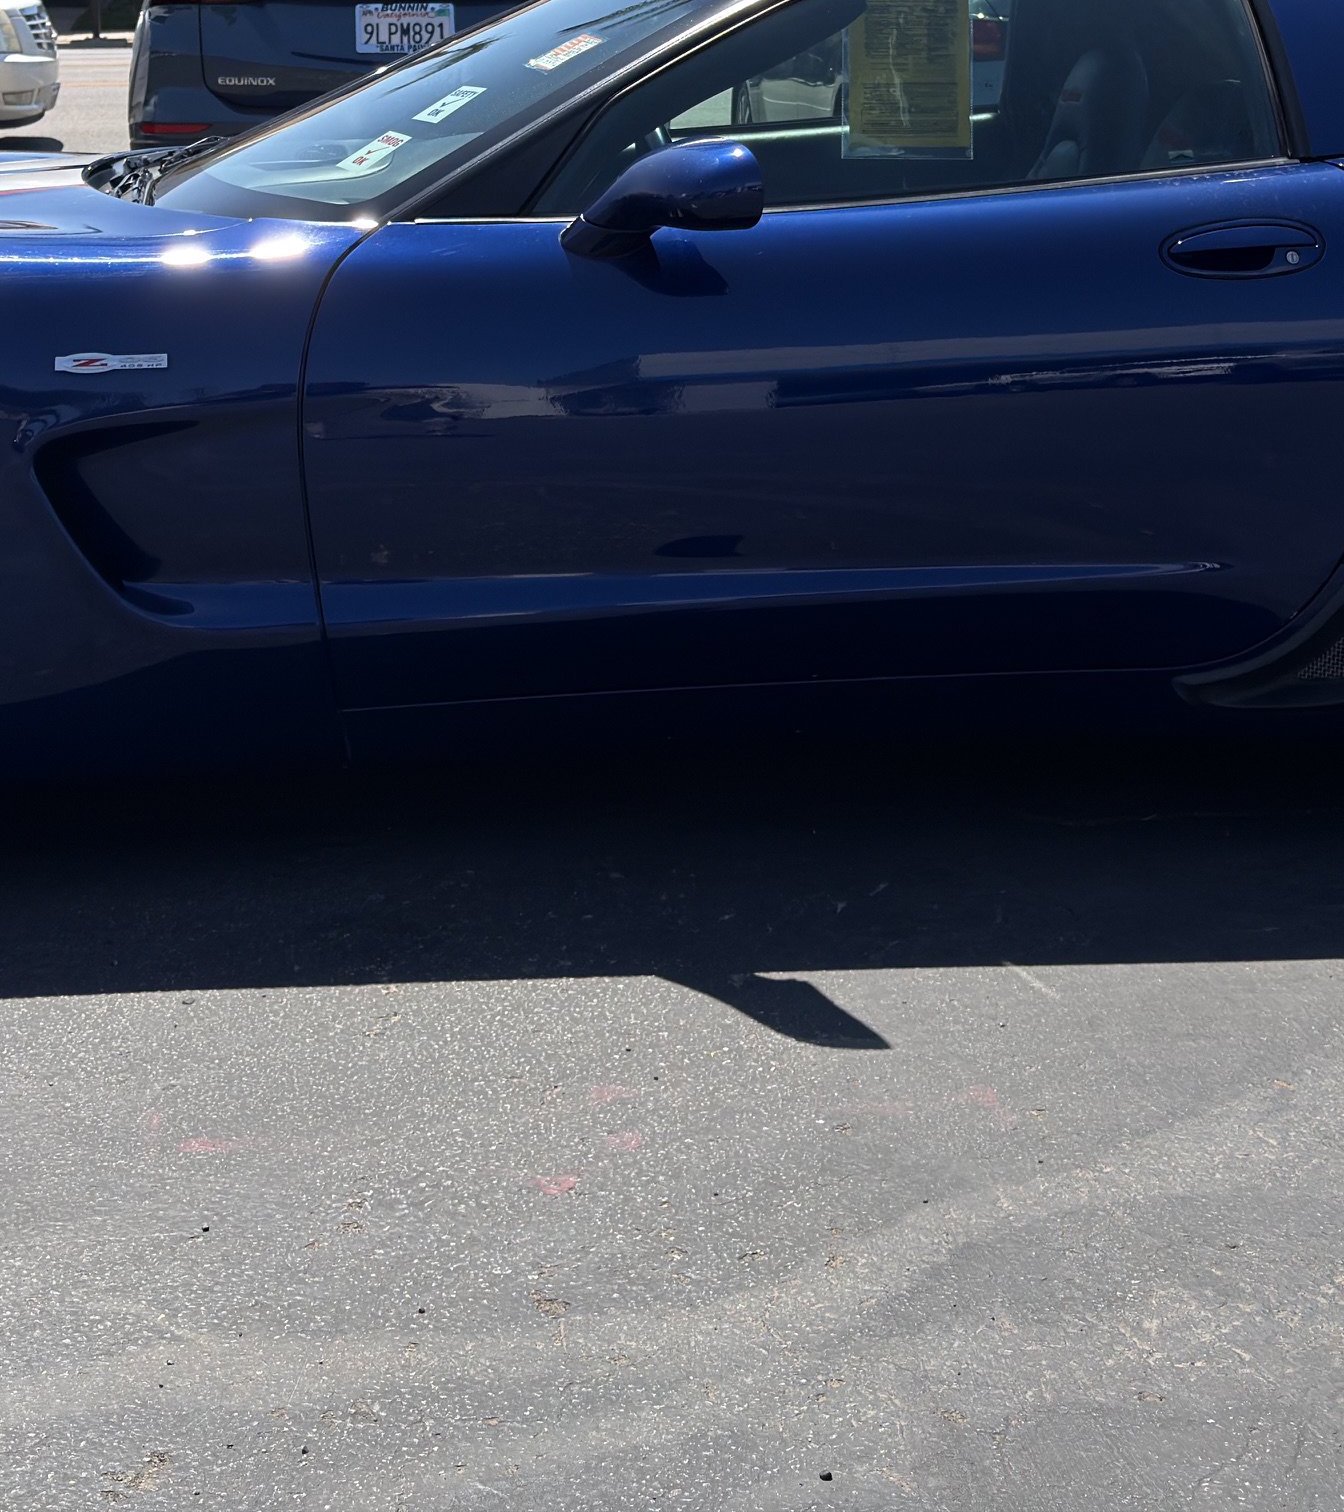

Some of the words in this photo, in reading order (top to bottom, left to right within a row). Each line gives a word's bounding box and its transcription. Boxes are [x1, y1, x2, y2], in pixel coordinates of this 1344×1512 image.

[363, 22, 444, 45] 9LPM891
[217, 76, 276, 86] EQUINOX
[377, 134, 404, 147] SMOG
[351, 155, 369, 166] OK
